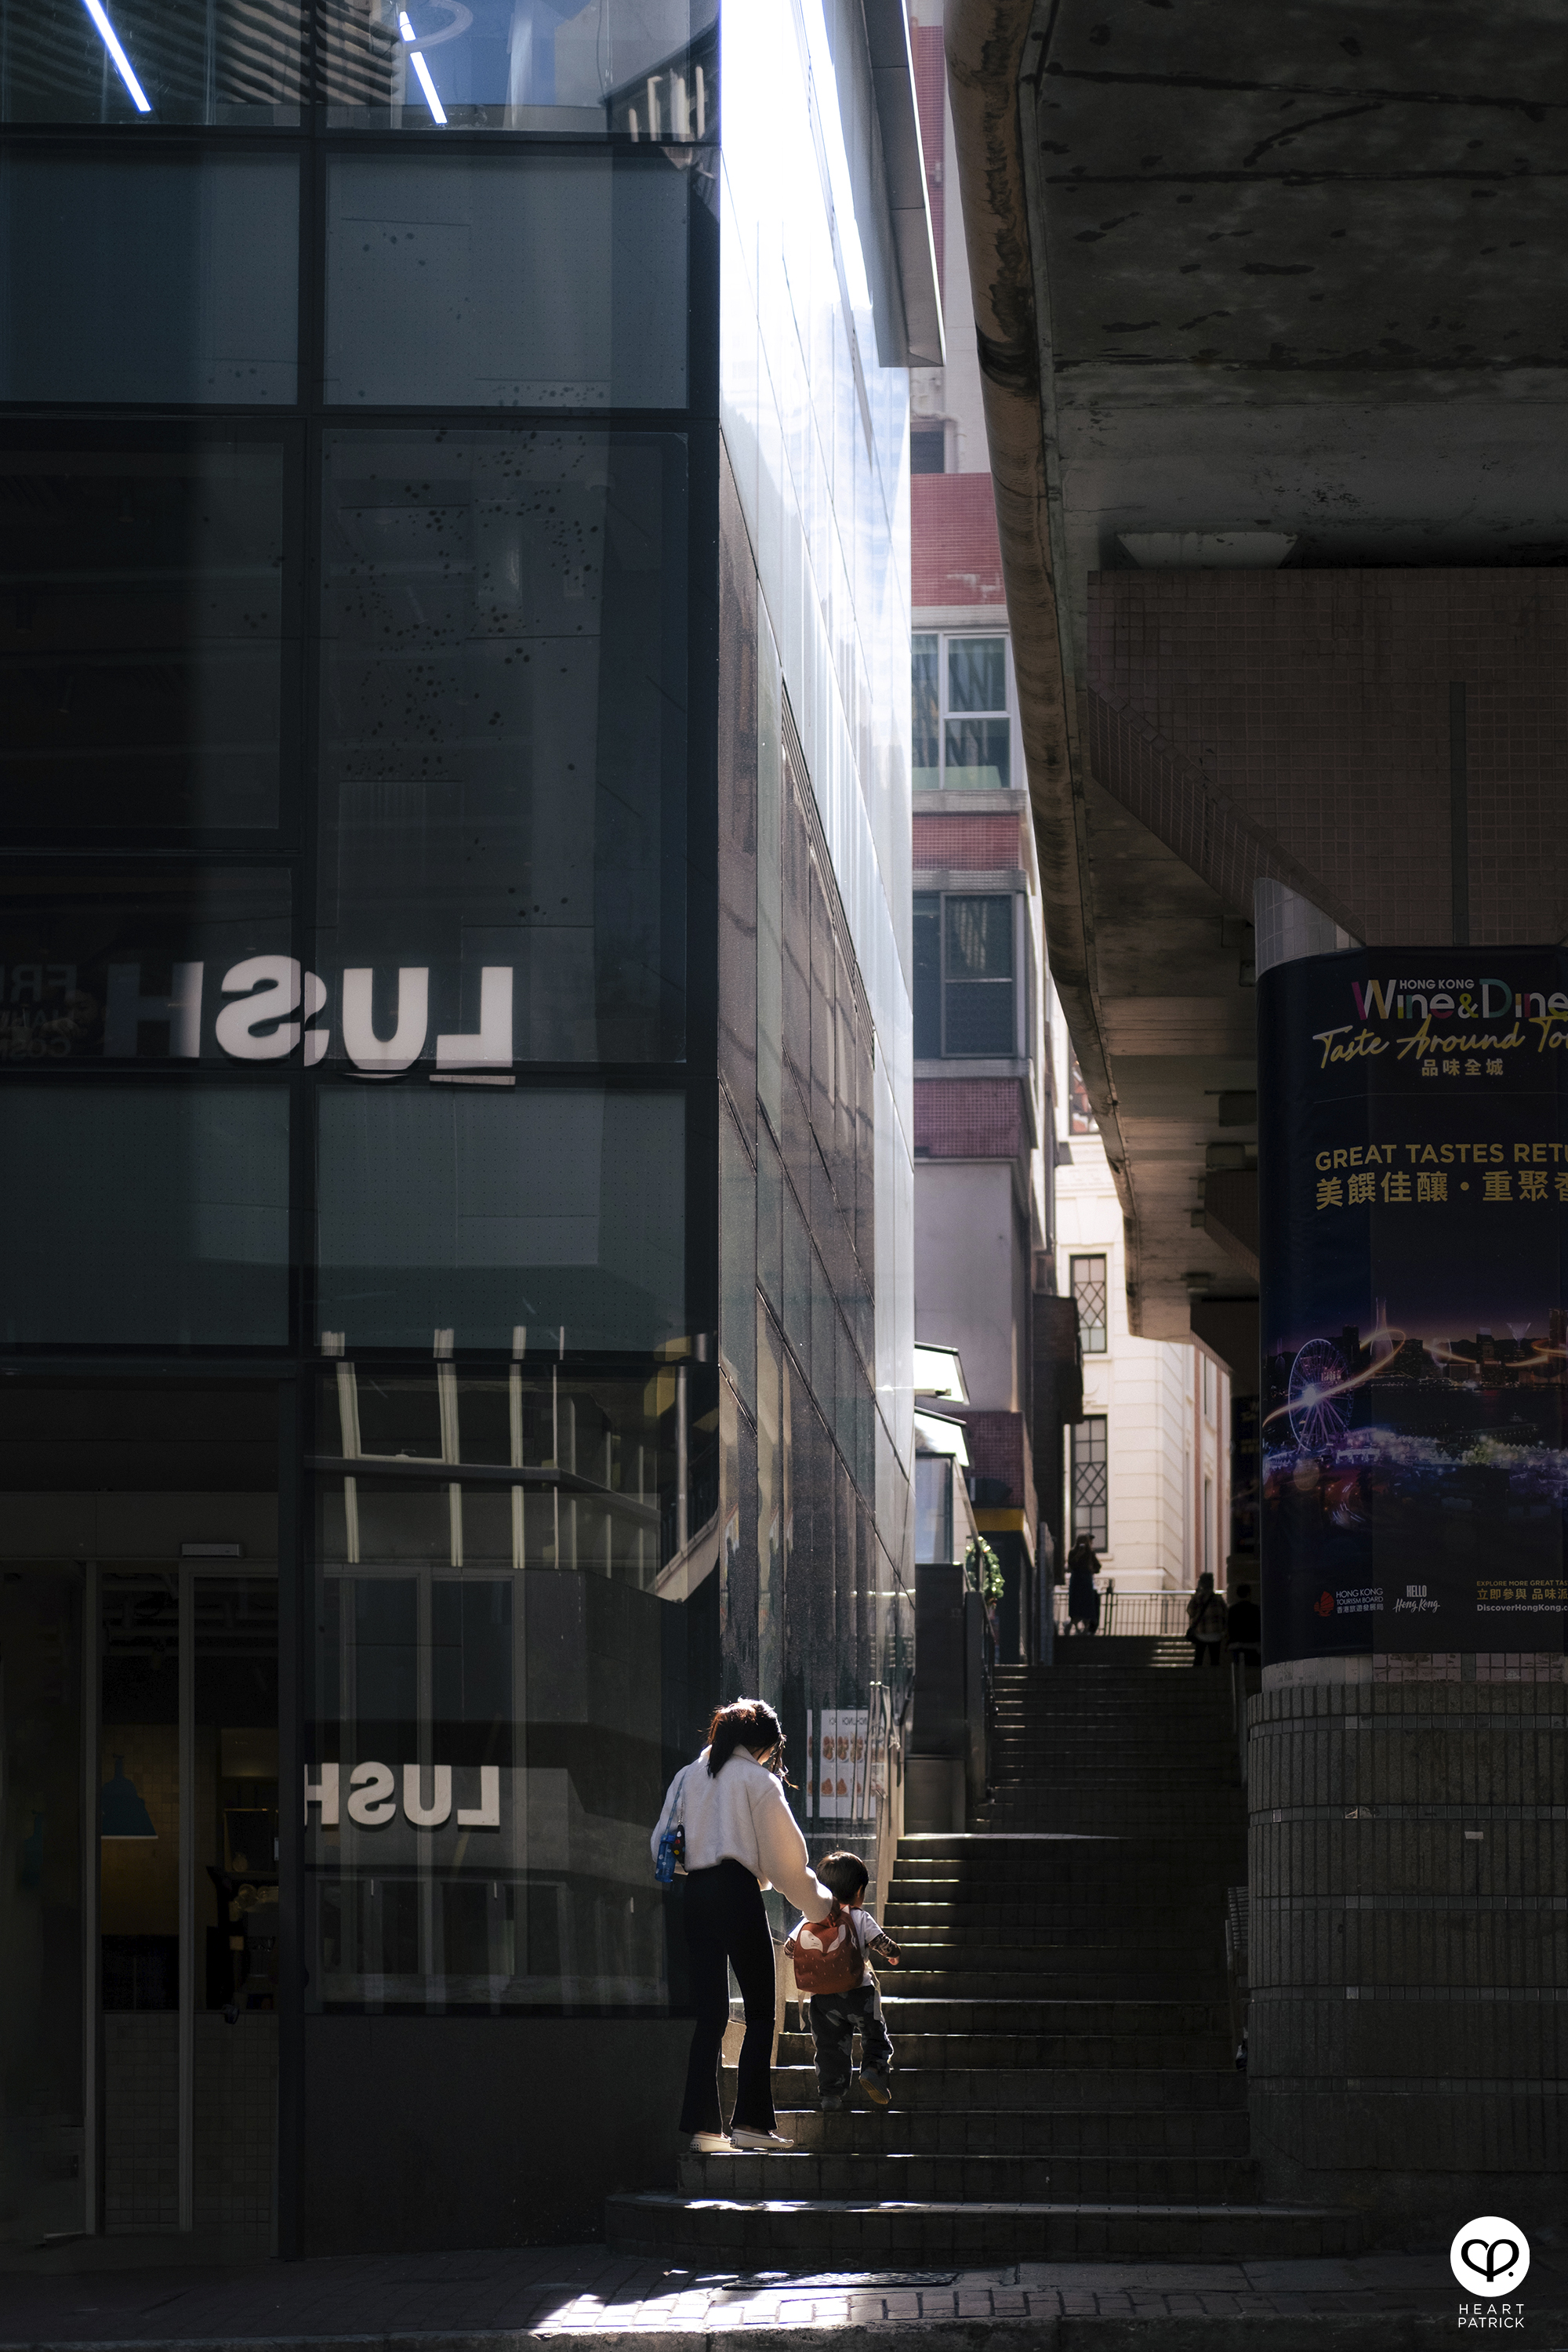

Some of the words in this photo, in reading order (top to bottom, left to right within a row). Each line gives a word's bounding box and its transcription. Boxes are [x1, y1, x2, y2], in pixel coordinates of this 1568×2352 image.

[1399, 979, 1436, 990] HONG
[1438, 978, 1475, 989] KONG
[1312, 1025, 1390, 1069] Taste
[1396, 1013, 1526, 1061] Around
[1528, 1015, 1568, 1053] To
[1421, 1058, 1504, 1076] 品味全城
[1315, 1144, 1397, 1171] GREAT
[1405, 1143, 1504, 1163] TASTES
[1514, 1143, 1568, 1163] RET
[1336, 1588, 1359, 1599] HONG
[1359, 1587, 1384, 1596] KONG
[1406, 1584, 1428, 1598] HELLO
[1476, 1588, 1527, 1600] 立即參與
[1336, 1597, 1361, 1606] TOURISM
[1392, 1598, 1418, 1613] Hong
[1418, 1598, 1441, 1613] Kong
